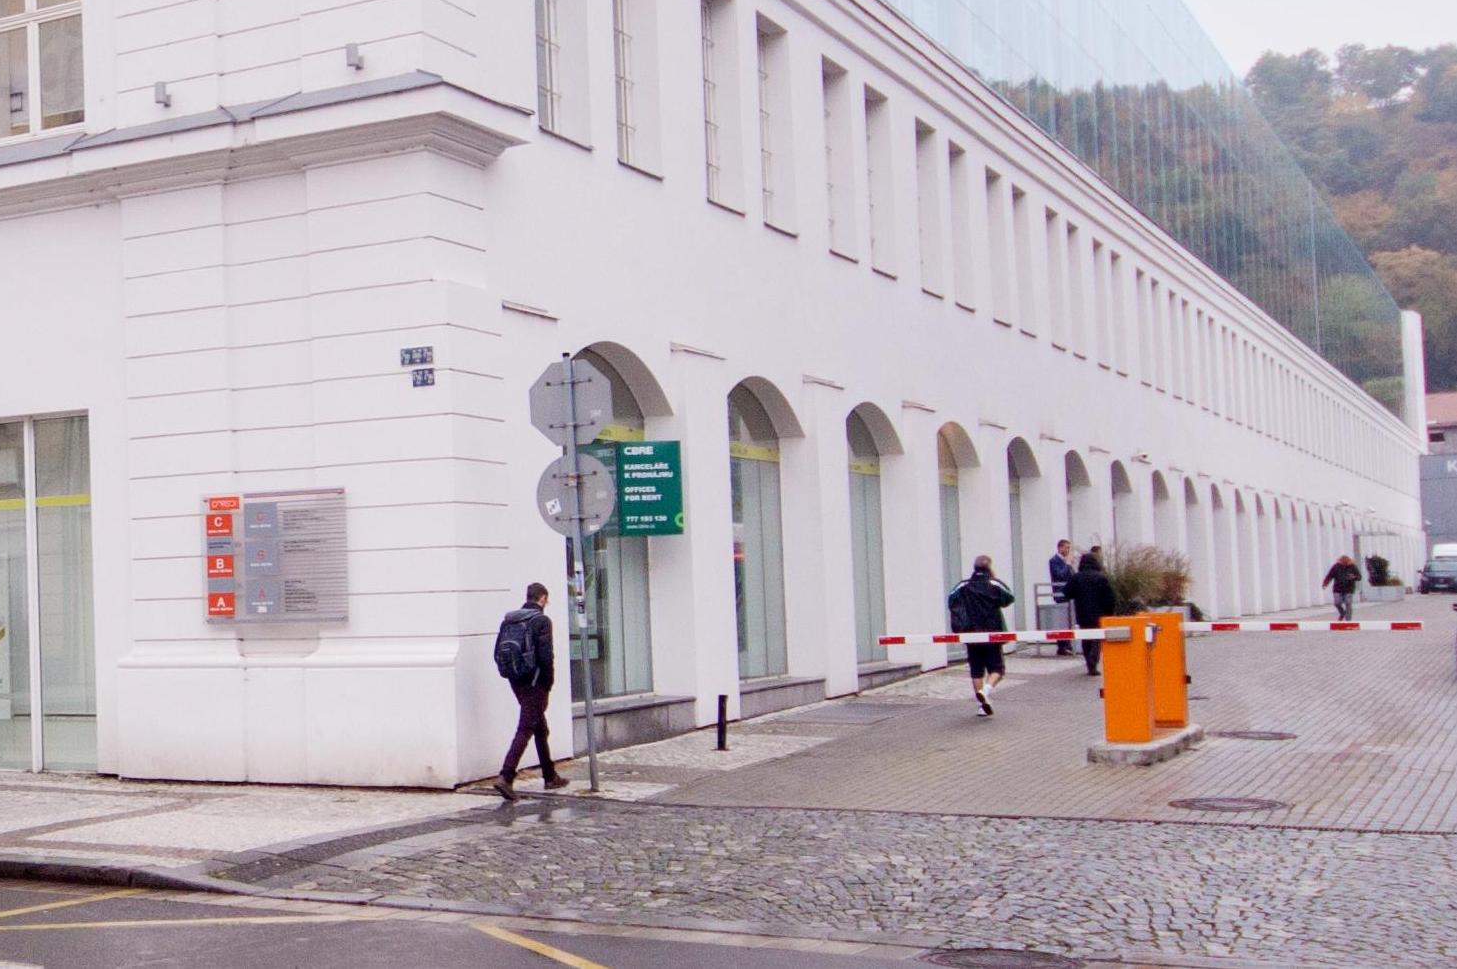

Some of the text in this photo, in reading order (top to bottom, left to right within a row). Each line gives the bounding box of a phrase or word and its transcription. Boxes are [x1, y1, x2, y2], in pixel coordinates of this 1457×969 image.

[624, 446, 654, 456] CBRE
[214, 516, 223, 527] C
[216, 558, 224, 569] B
[217, 597, 226, 608] A
